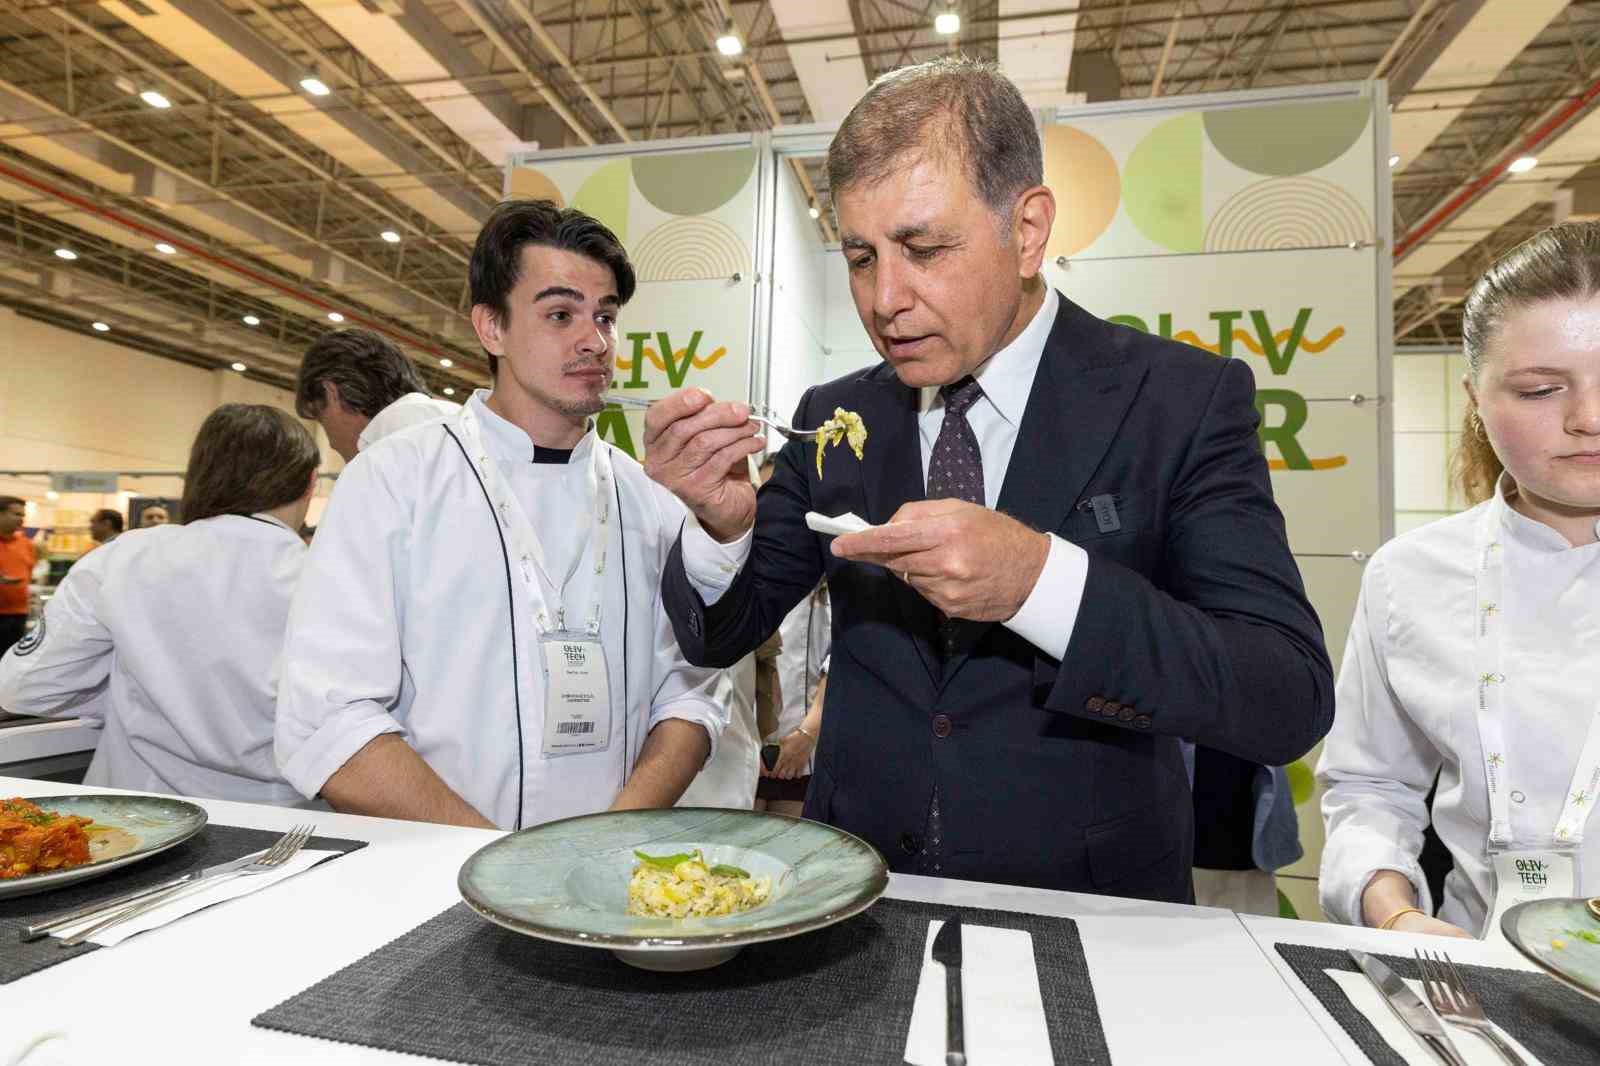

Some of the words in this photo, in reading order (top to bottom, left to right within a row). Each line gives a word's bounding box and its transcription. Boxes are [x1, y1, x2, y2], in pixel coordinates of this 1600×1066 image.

[610, 330, 704, 389] IV
[1515, 858, 1542, 871] OLIV
[1518, 871, 1548, 885] TECH
